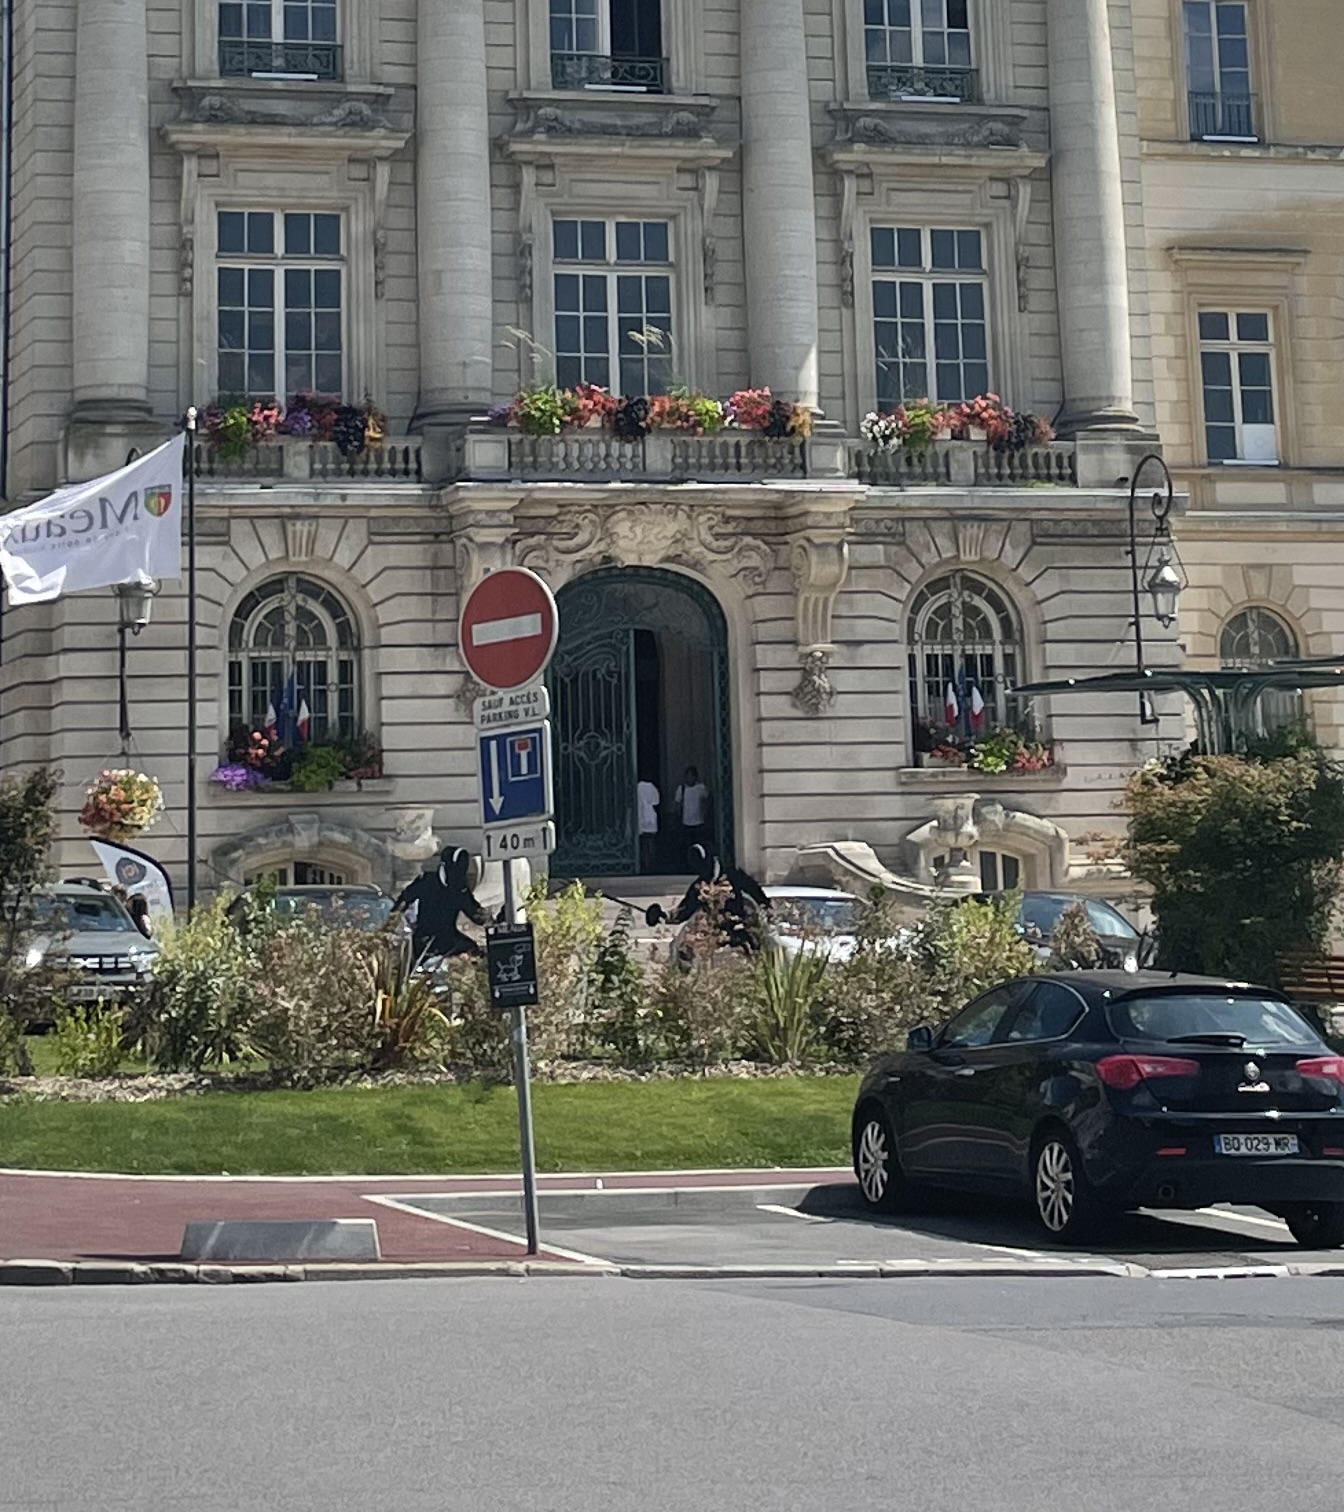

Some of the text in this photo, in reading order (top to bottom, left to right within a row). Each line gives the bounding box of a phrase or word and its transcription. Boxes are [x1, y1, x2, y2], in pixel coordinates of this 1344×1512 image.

[481, 697, 504, 710] SAUF
[480, 709, 520, 725] PARKING
[499, 833, 536, 850] 40 m
